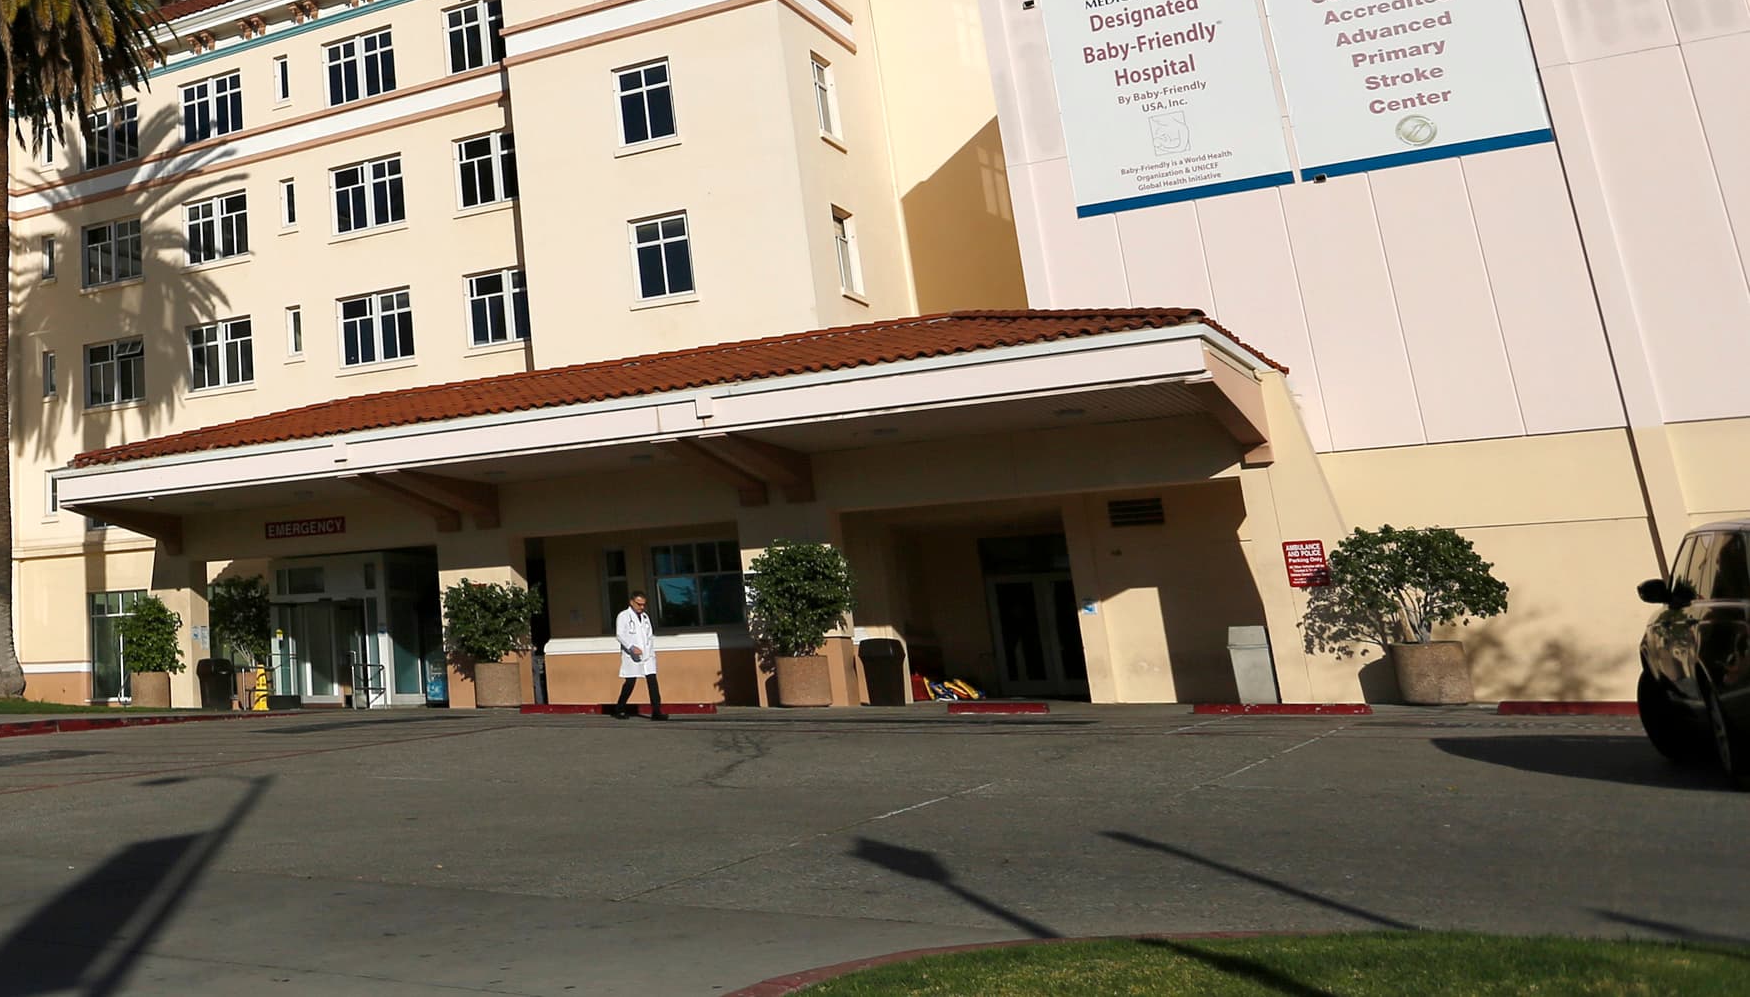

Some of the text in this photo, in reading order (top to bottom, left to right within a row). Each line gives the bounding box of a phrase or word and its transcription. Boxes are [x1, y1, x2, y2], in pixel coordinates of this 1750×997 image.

[1336, 11, 1452, 47] Advanced
[1351, 40, 1445, 68] Primary
[1114, 53, 1196, 87] Hospital
[1365, 67, 1444, 90] Stroke
[1117, 79, 1207, 105] By Baby-Friendly
[1369, 89, 1451, 114] Center
[1141, 97, 1188, 113] USA, Inc.
[1121, 161, 1170, 176] Baby-Friendly
[1185, 154, 1206, 164] World
[1207, 149, 1233, 161] Health
[1136, 169, 1184, 182] Organization
[1191, 162, 1219, 173] UNICEF
[1138, 172, 1222, 191] Global Health Initiative
[268, 519, 342, 537] EMERGENCY
